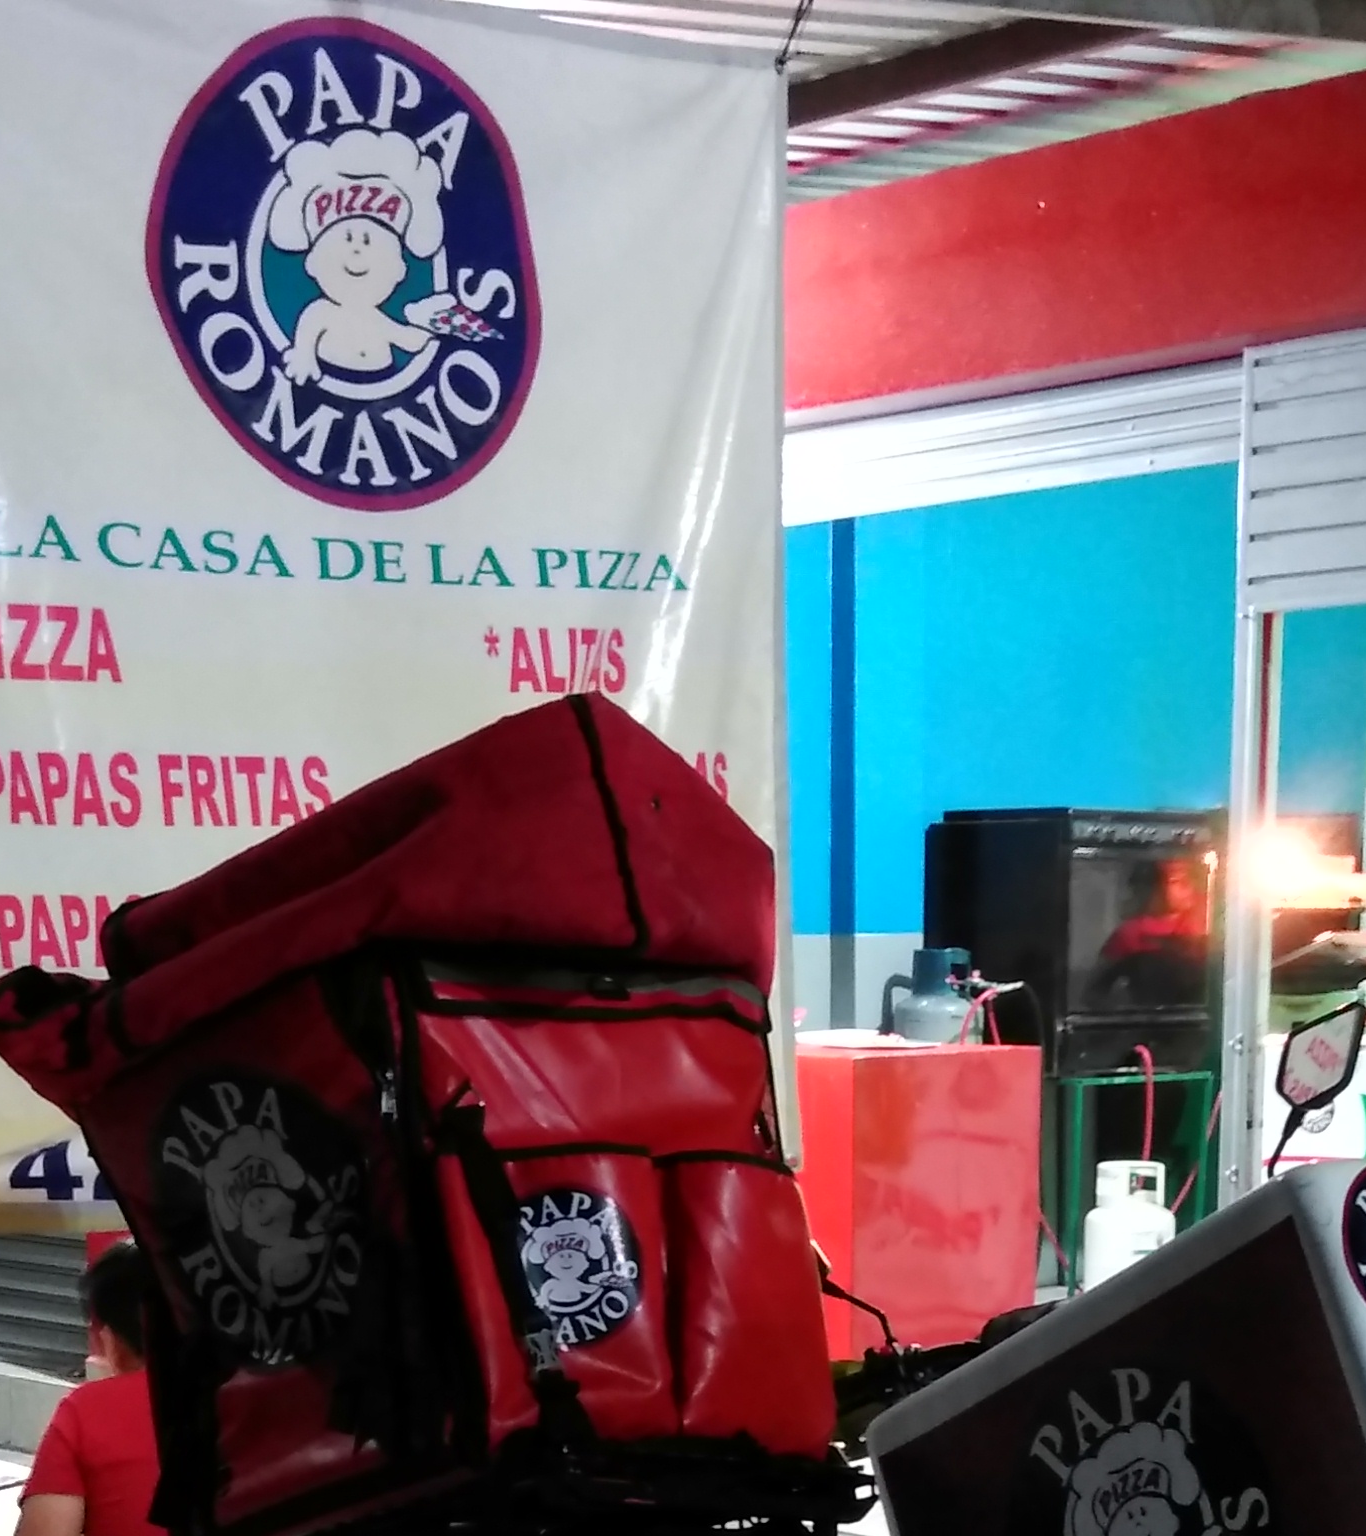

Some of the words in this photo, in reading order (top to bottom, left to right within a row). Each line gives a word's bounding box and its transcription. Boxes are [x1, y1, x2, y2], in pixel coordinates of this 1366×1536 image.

[239, 47, 469, 189] PAPA
[315, 185, 402, 226] PIZZA
[97, 523, 295, 578] CASA
[313, 537, 408, 584] DE
[427, 543, 514, 589] LA
[532, 547, 690, 592] PIZZA
[158, 751, 332, 827] FRITAS
[163, 1081, 289, 1184] PAPA
[520, 1192, 614, 1235] PAPA
[1030, 1368, 1193, 1486] PAPA
[1098, 1465, 1162, 1517] PIZZA
